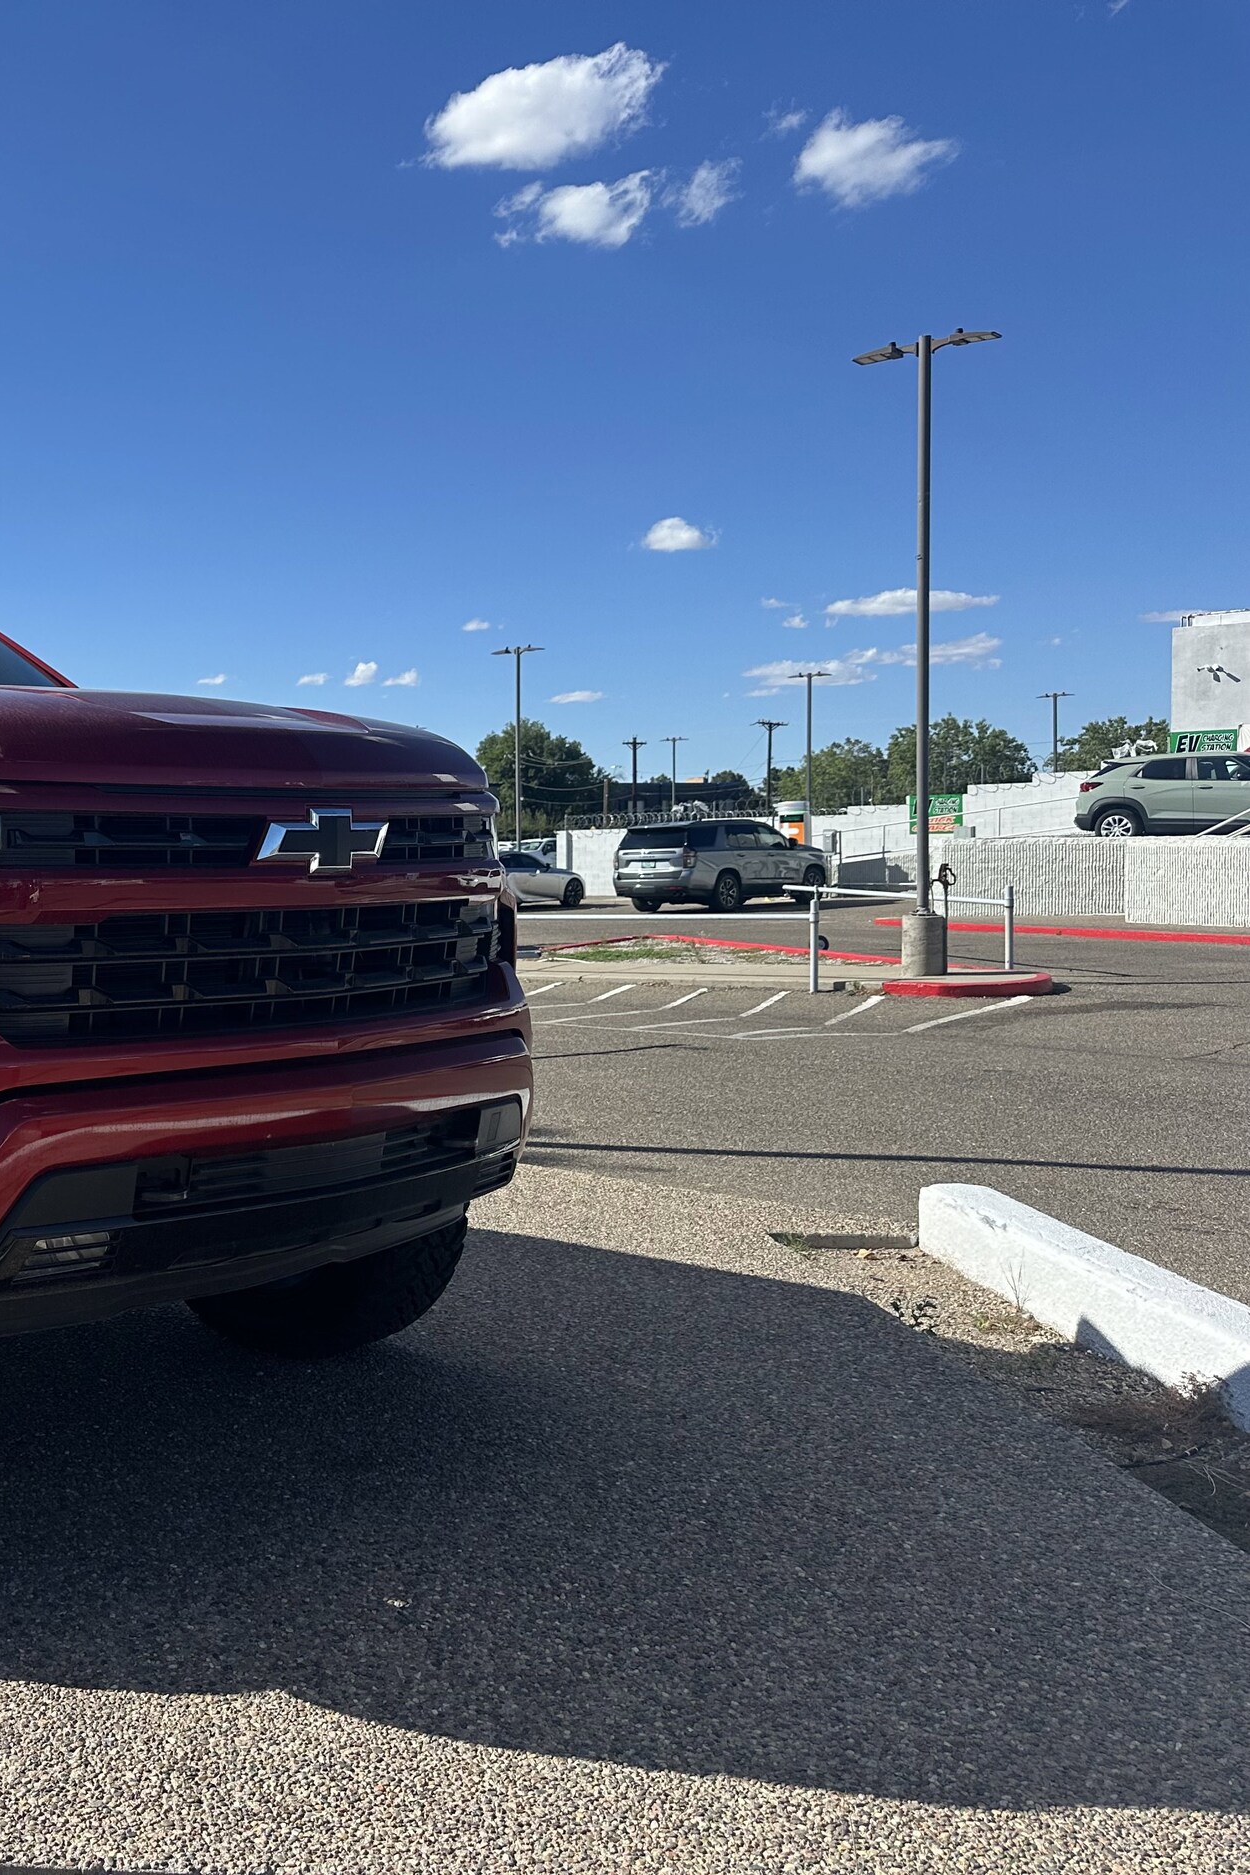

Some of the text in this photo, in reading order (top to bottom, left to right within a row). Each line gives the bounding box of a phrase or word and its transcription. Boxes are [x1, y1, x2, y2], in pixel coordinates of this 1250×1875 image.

[1202, 733, 1234, 742] CHARGING
[1175, 733, 1202, 753] EV
[1201, 743, 1233, 752] STATION
